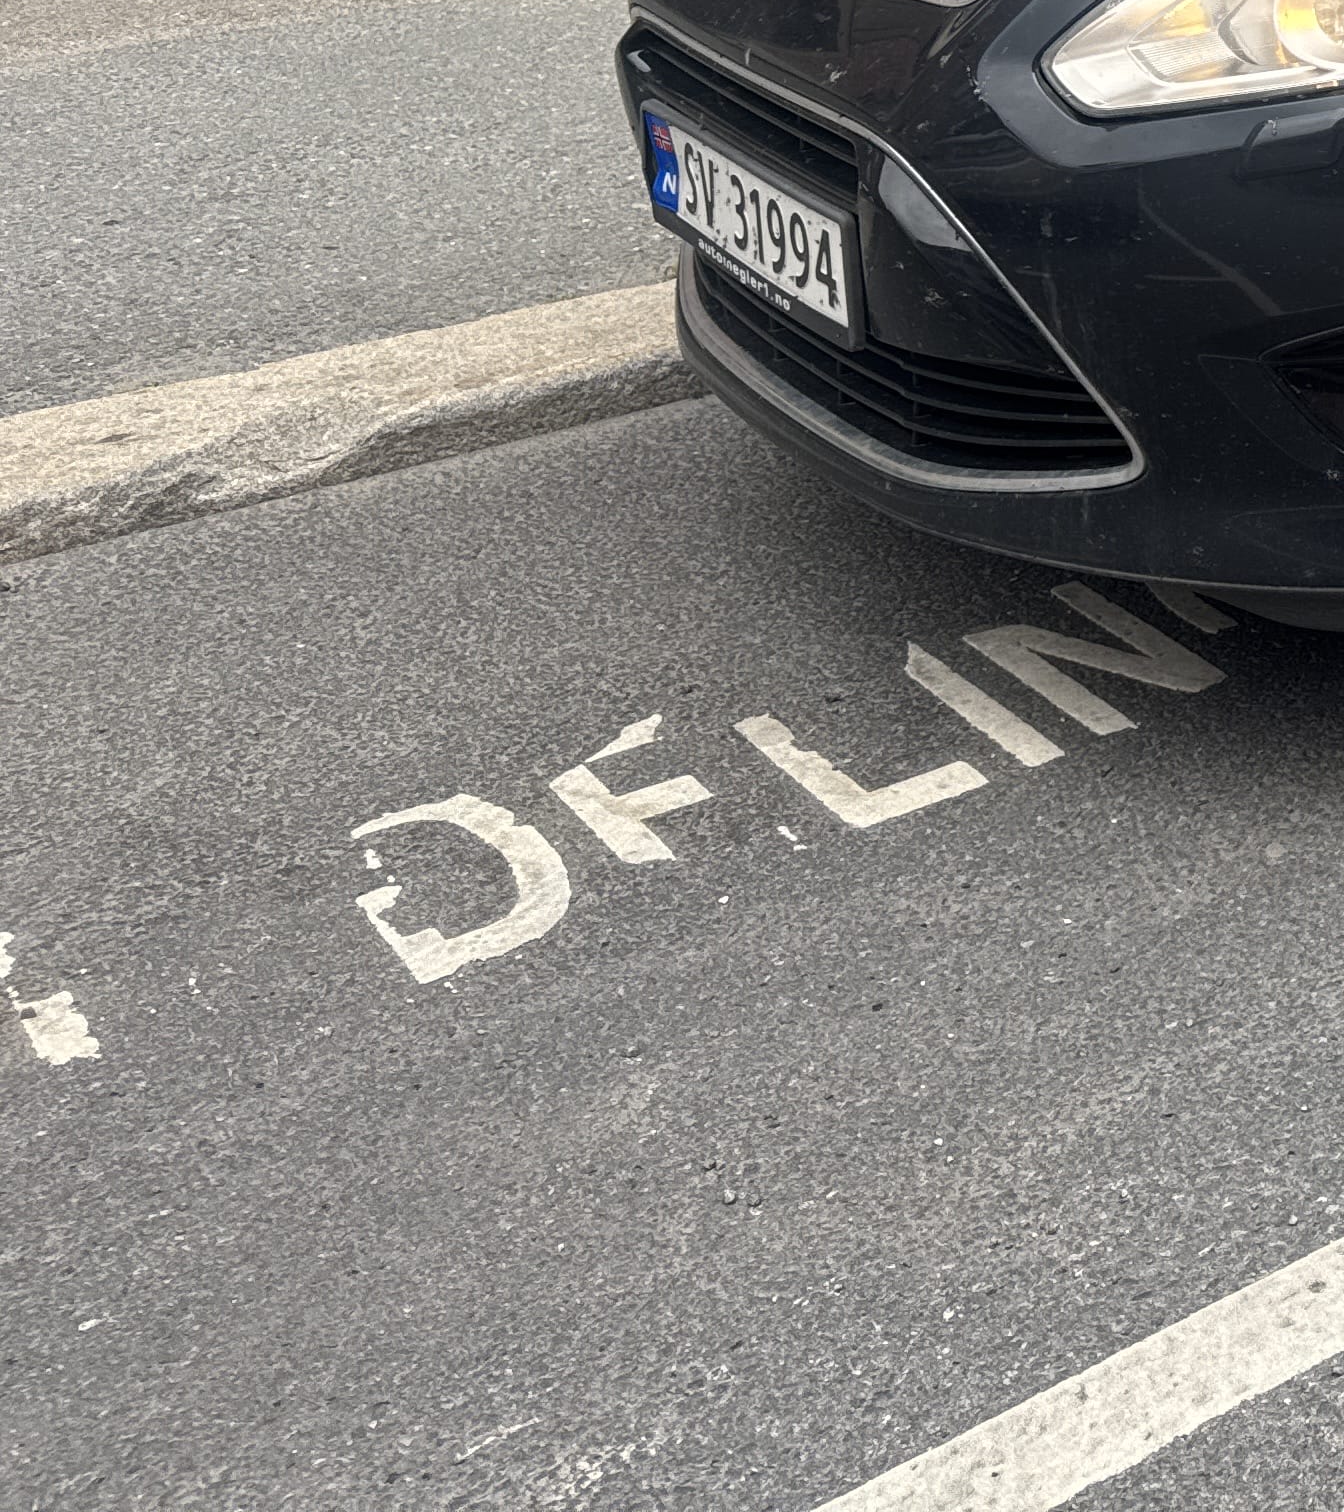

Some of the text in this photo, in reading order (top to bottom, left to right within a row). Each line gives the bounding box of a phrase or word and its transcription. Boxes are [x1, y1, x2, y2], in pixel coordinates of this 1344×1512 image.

[663, 171, 677, 195] N
[684, 142, 841, 310] SV 31994
